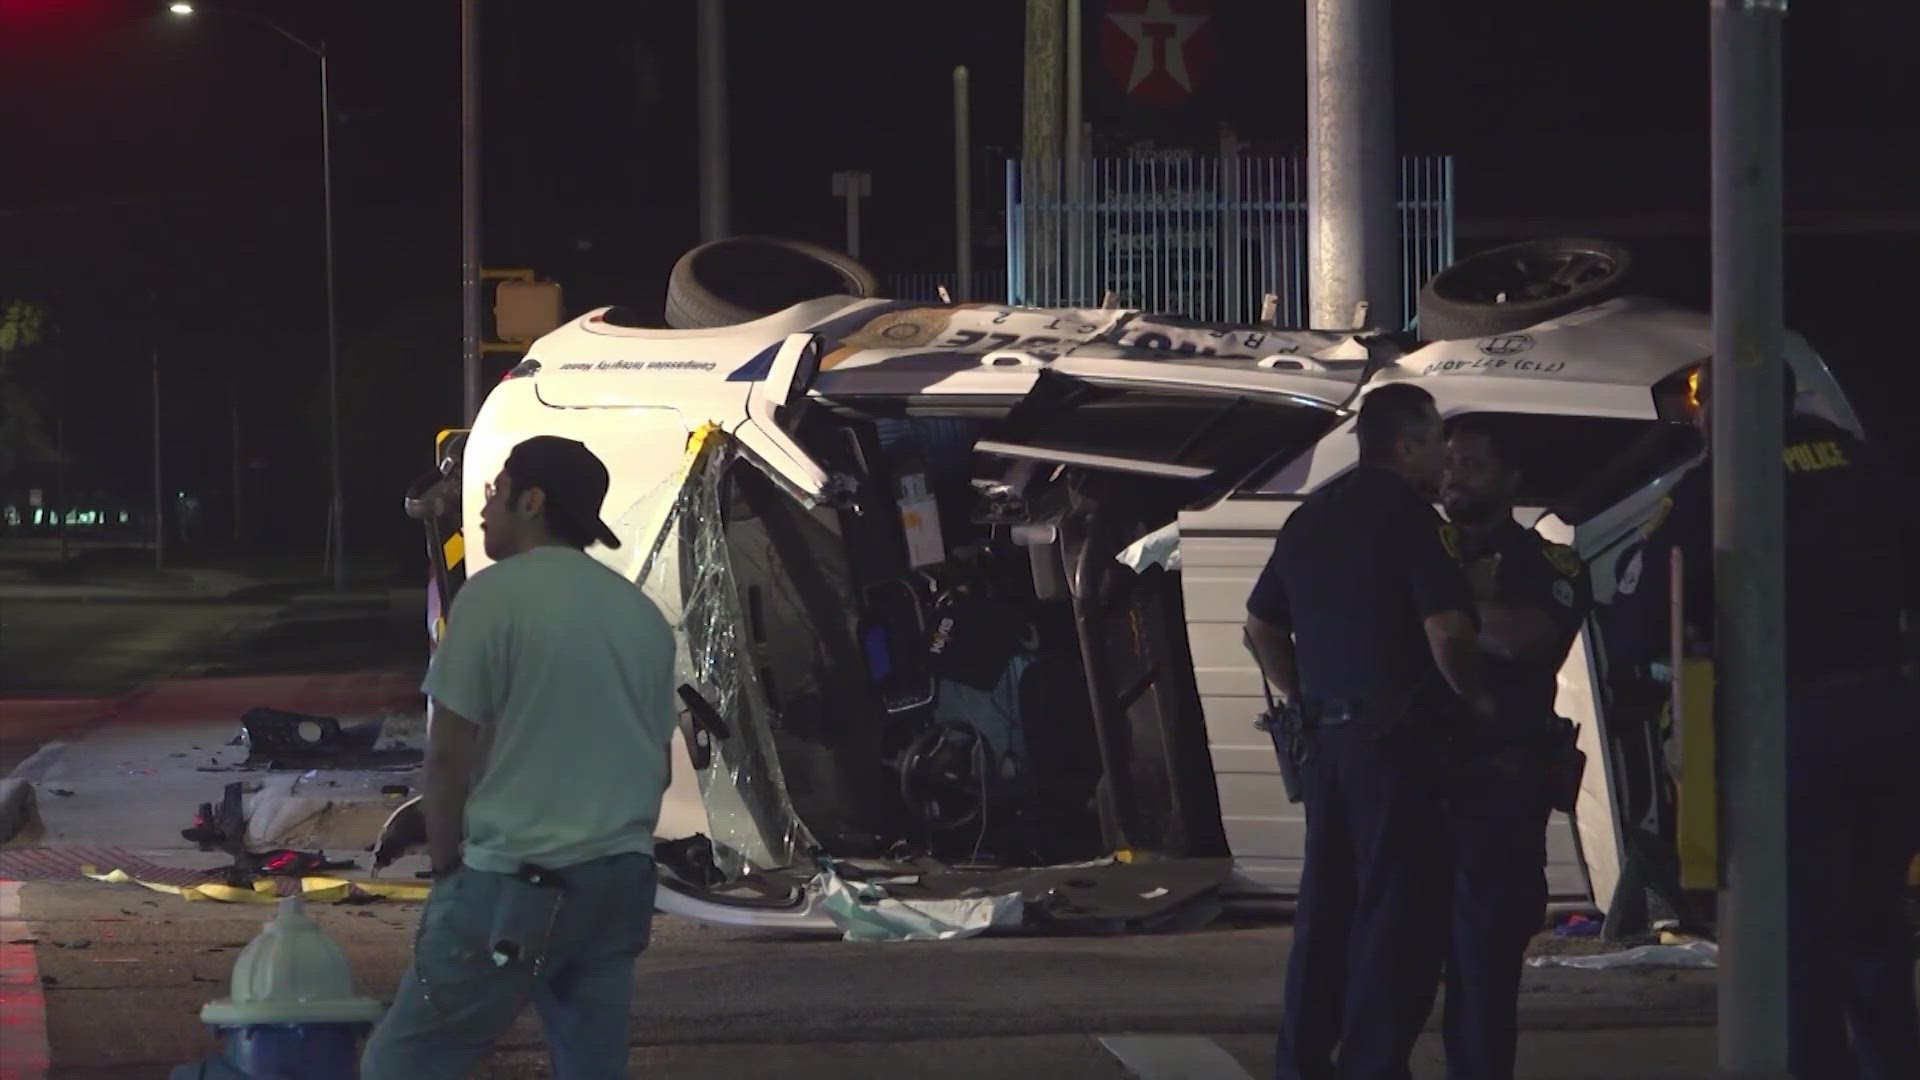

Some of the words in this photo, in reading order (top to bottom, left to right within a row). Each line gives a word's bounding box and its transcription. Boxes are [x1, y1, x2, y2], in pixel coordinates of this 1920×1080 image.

[595, 360, 645, 370] Integrity
[646, 360, 717, 371] Compassion
[1784, 441, 1849, 472] POLICE
